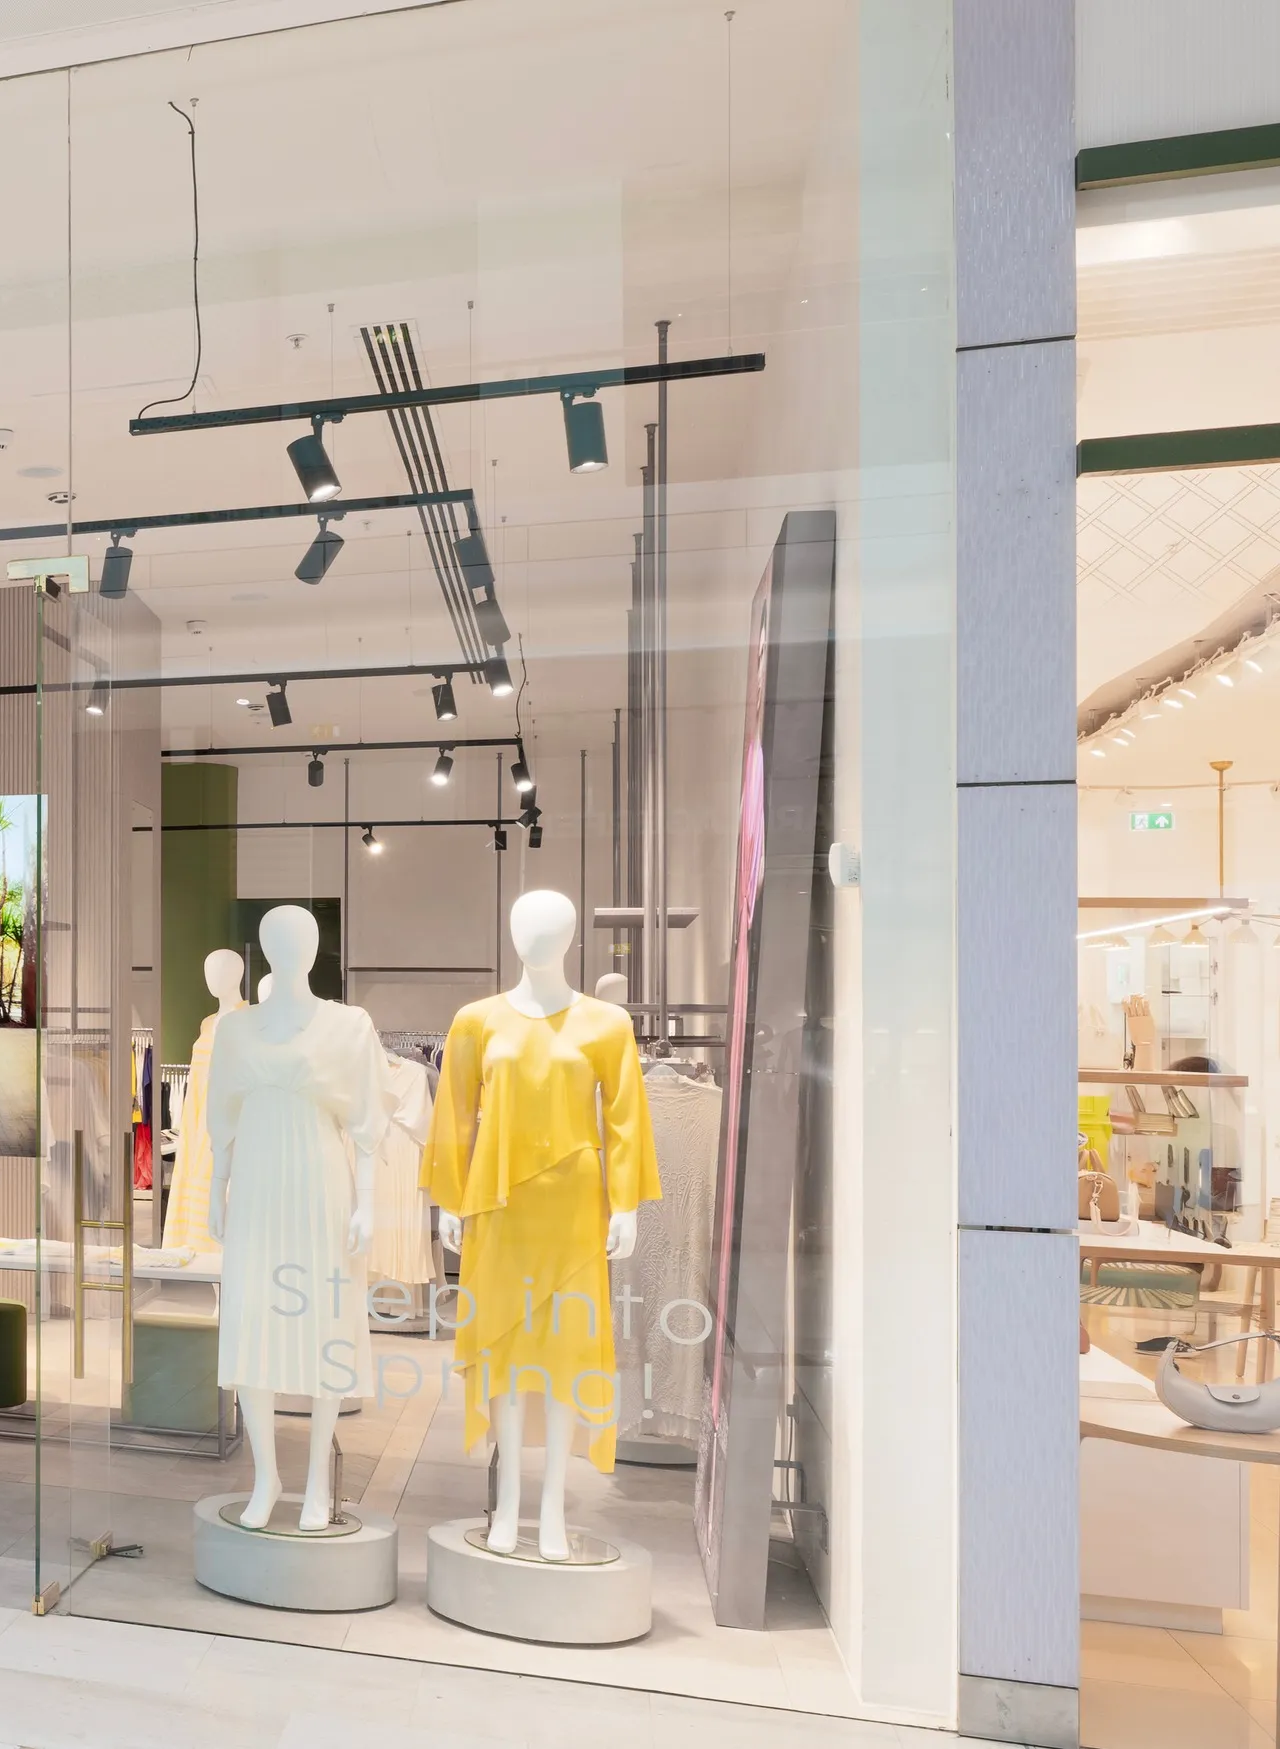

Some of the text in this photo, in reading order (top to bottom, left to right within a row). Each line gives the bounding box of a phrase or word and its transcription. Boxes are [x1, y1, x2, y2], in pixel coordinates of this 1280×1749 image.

[270, 1262, 714, 1346] Step into
[319, 1338, 655, 1430] Spring!
